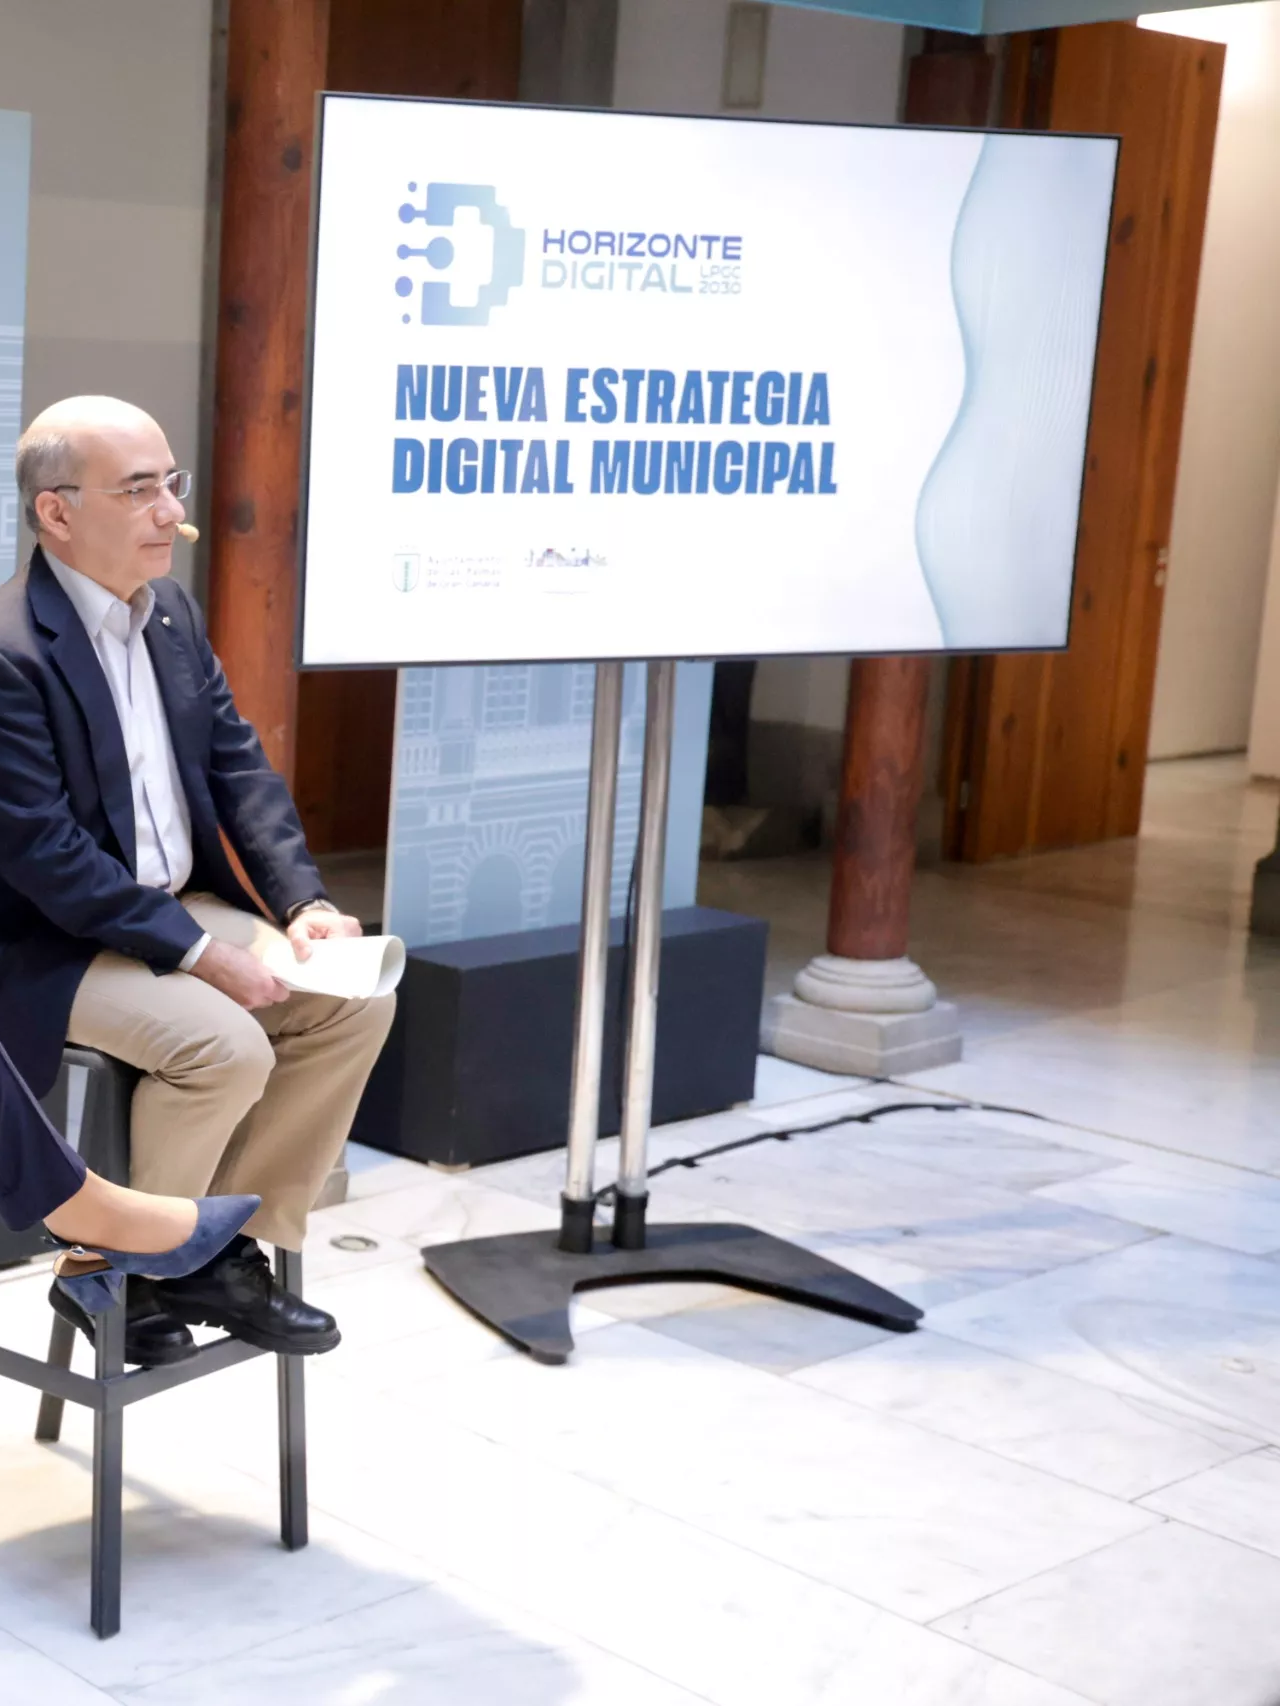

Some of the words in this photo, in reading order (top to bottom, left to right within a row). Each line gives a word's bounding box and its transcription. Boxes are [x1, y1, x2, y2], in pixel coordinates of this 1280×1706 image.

[543, 228, 743, 261] HORIZONTE
[541, 259, 693, 294] DIGITAL
[698, 280, 742, 295] 2030
[395, 364, 548, 423] NUEVA
[564, 367, 831, 427] ESTRATEGIA
[392, 437, 574, 495] DIGITAL
[590, 440, 838, 496] MUNICIPAL
